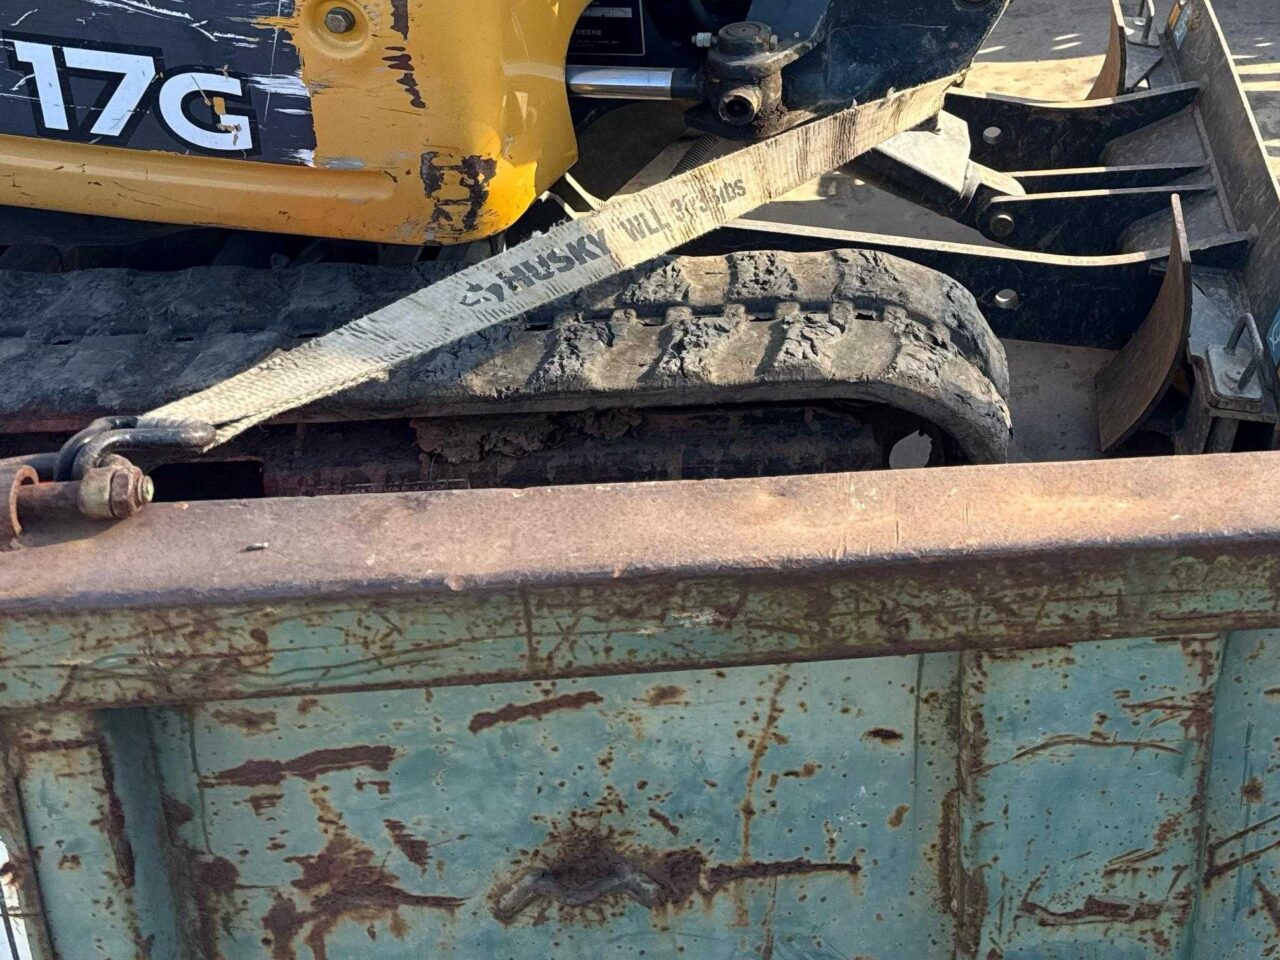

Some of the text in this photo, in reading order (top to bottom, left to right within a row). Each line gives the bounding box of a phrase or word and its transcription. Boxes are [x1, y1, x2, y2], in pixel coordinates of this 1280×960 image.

[13, 39, 253, 151] 17G
[496, 227, 609, 290] HUSKY
[619, 211, 671, 242] WLL
